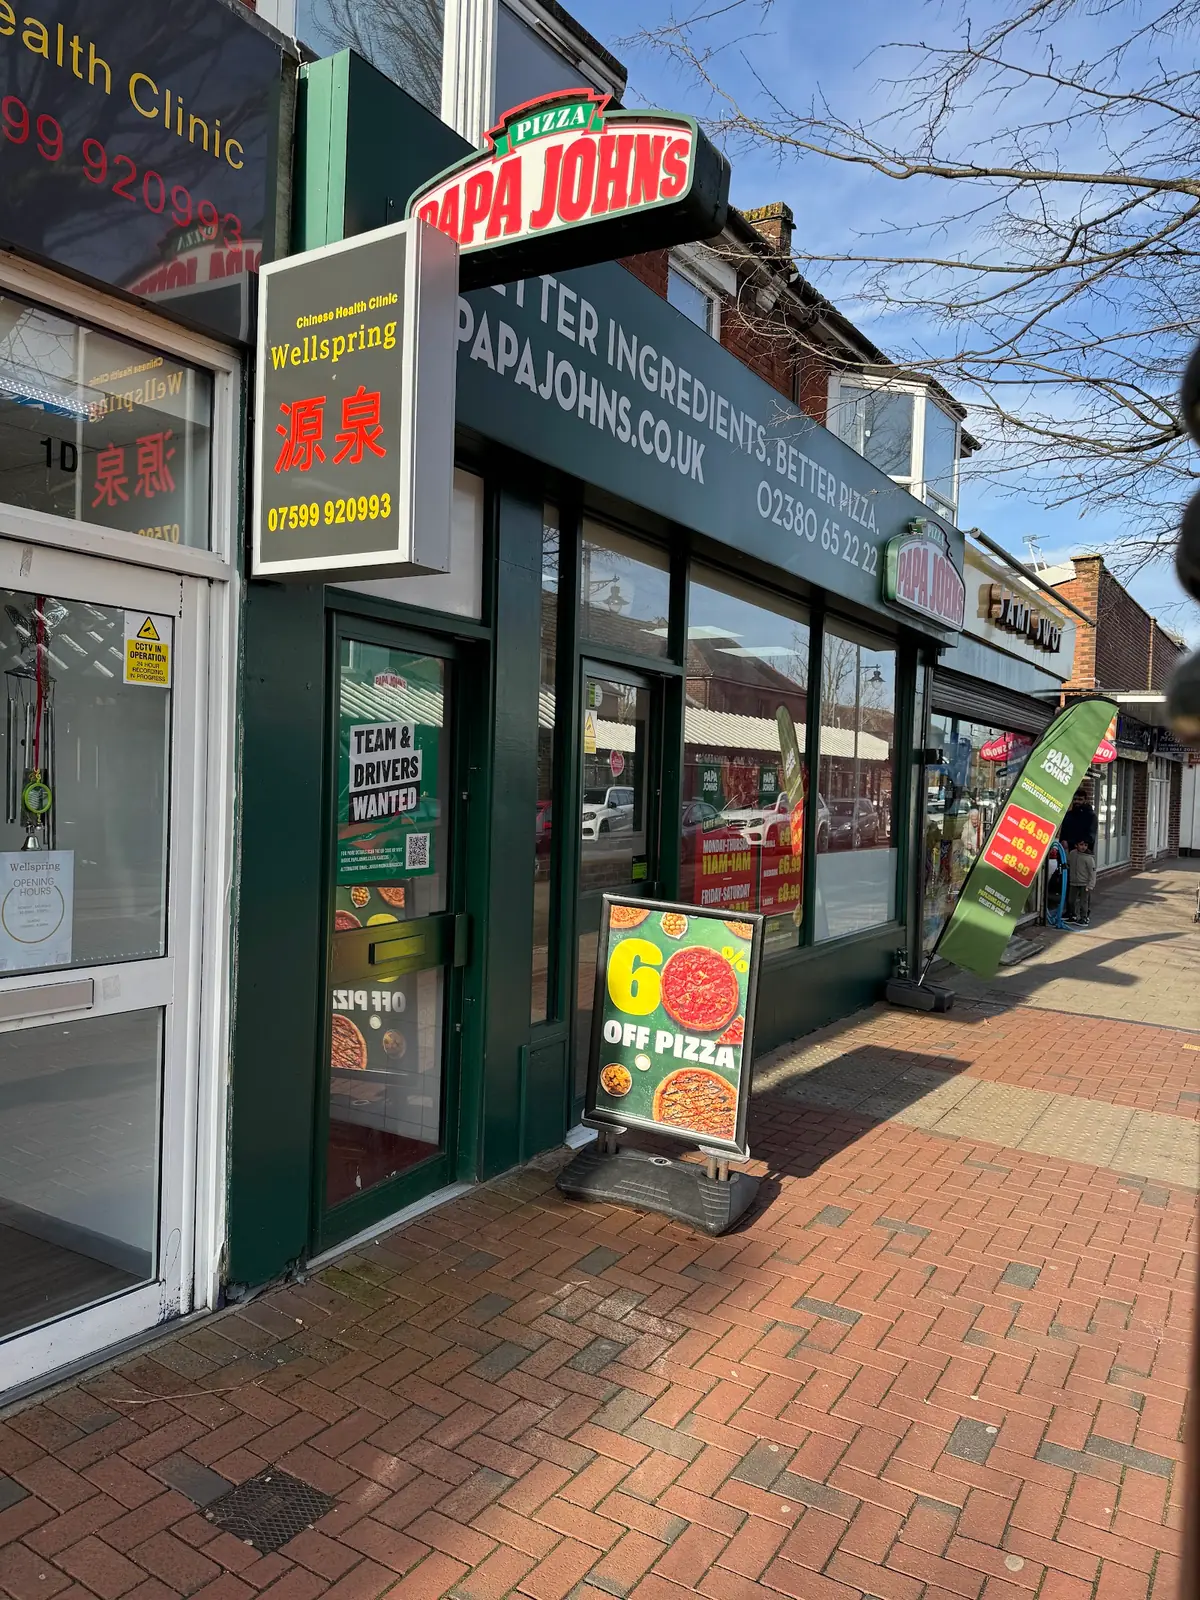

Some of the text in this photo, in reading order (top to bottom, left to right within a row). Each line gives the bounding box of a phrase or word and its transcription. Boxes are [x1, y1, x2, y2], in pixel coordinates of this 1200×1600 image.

[128, 72, 244, 170] Clinic
[517, 105, 585, 142] PIZZA
[82, 138, 243, 254] 920993
[529, 133, 690, 230] JOHN'S
[296, 292, 398, 329] Chinese Health Clinic
[270, 321, 398, 371] Wellspring
[456, 295, 706, 485] PAPAJOHNS.CO.UK
[490, 274, 880, 536] TTER INGREDIENTS. BETTER PIZZA.
[273, 385, 387, 475] 源泉
[40, 436, 79, 474] 1D
[267, 492, 392, 532] 07599 920993
[757, 480, 879, 577] 02380 65 22 22
[898, 547, 928, 608] PAPA
[130, 651, 166, 663] OPERATION
[135, 642, 162, 653] CCTV IN
[132, 667, 164, 675] RECORDING
[136, 674, 166, 682] PROGRESS
[354, 725, 411, 755] TEAM &
[353, 755, 419, 788] DRIVERS
[703, 770, 718, 782] PAPA
[1040, 759, 1072, 786] JOHNS
[1046, 748, 1074, 777] PAPA
[702, 782, 718, 792] JOHNS
[762, 772, 775, 783] PAPA
[762, 783, 775, 792] JOHNS
[352, 786, 417, 821] WANTED
[1021, 782, 1051, 806] COLLECTION
[1018, 816, 1050, 845] £4.99
[1011, 836, 1038, 860] £6.99
[10, 861, 61, 873] Wellspring
[778, 855, 801, 875] £6.99
[1002, 853, 1030, 876] £8.99
[13, 877, 54, 888] OPENING
[20, 887, 52, 897] HOURS
[702, 883, 751, 904] FRIDAY-SATURDAY
[778, 882, 801, 903] £8.99
[603, 1020, 736, 1069] OFF PIZZA
